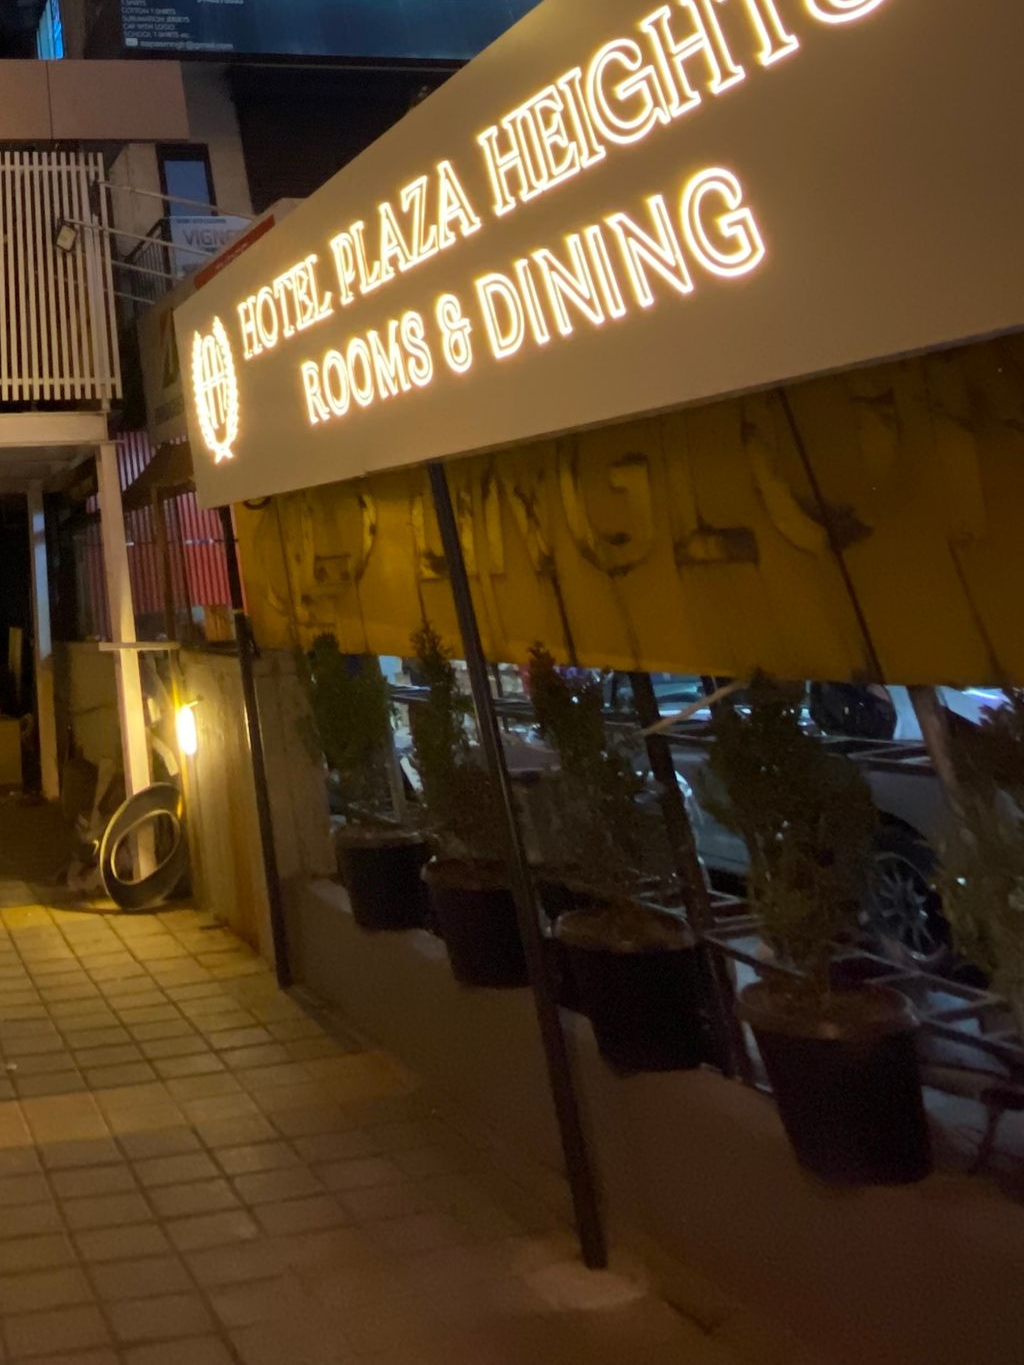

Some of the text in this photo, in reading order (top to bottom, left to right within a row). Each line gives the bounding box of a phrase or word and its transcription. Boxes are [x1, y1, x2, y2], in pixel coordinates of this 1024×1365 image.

[236, 253, 335, 361] HOTEL
[329, 159, 483, 307] PLAZA
[300, 166, 767, 426] ROOMS & DINING
